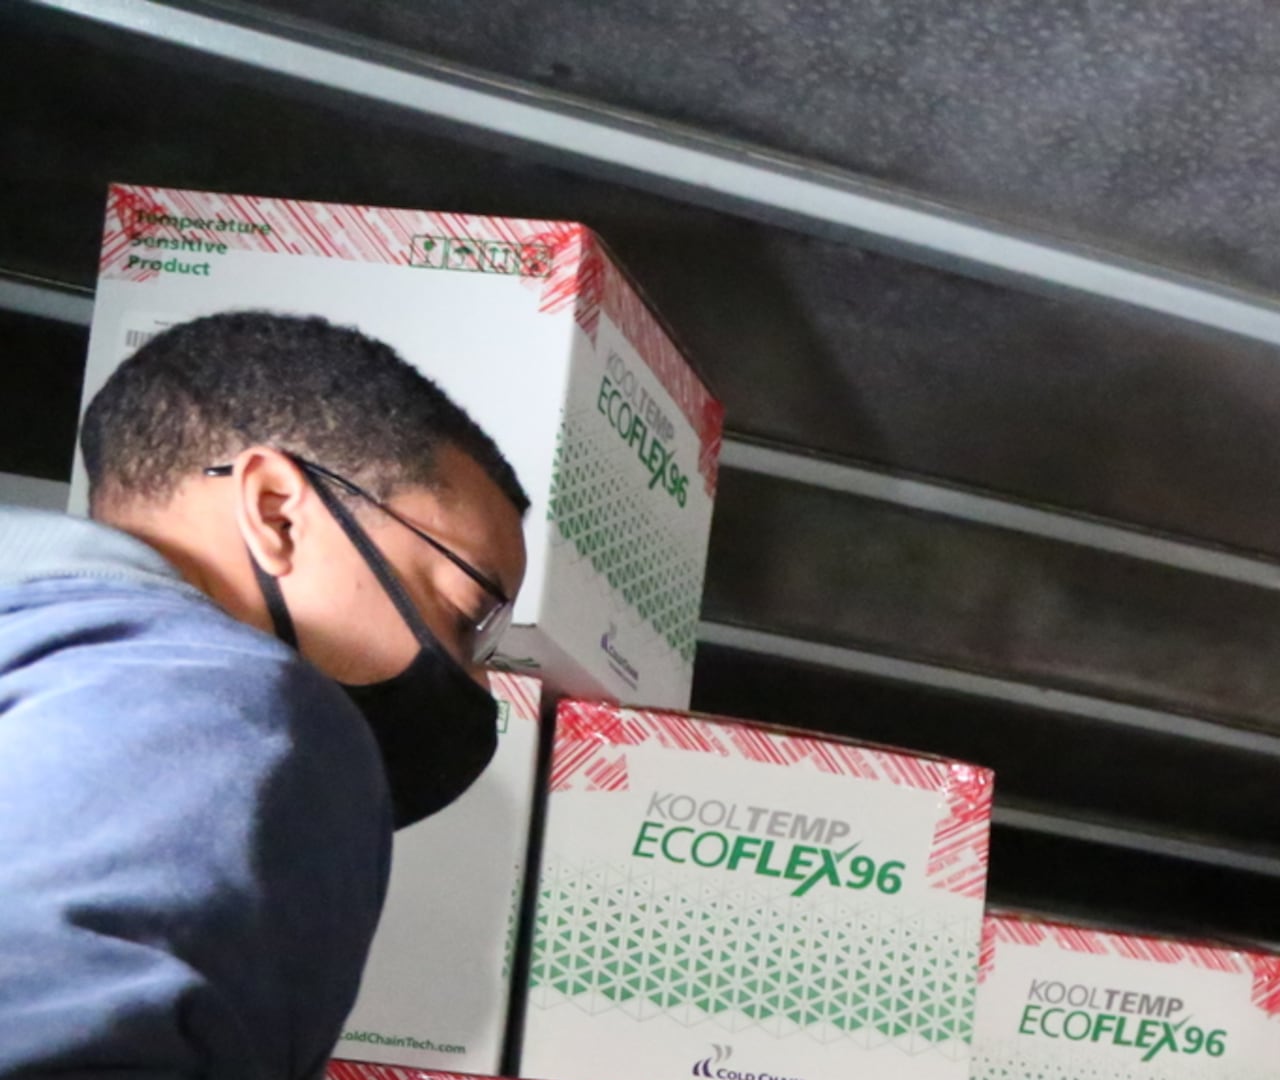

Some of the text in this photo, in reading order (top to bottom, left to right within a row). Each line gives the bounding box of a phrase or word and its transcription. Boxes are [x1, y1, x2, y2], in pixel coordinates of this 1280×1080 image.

[136, 209, 271, 234] Temperature
[131, 232, 228, 254] Sensitive
[128, 255, 210, 276] Product
[606, 351, 675, 442] KOOLTEMP
[646, 791, 851, 844] KOOLTEMP
[1027, 979, 1185, 1018] KOOLTEMP
[341, 1032, 466, 1054] oldChainTech.com
